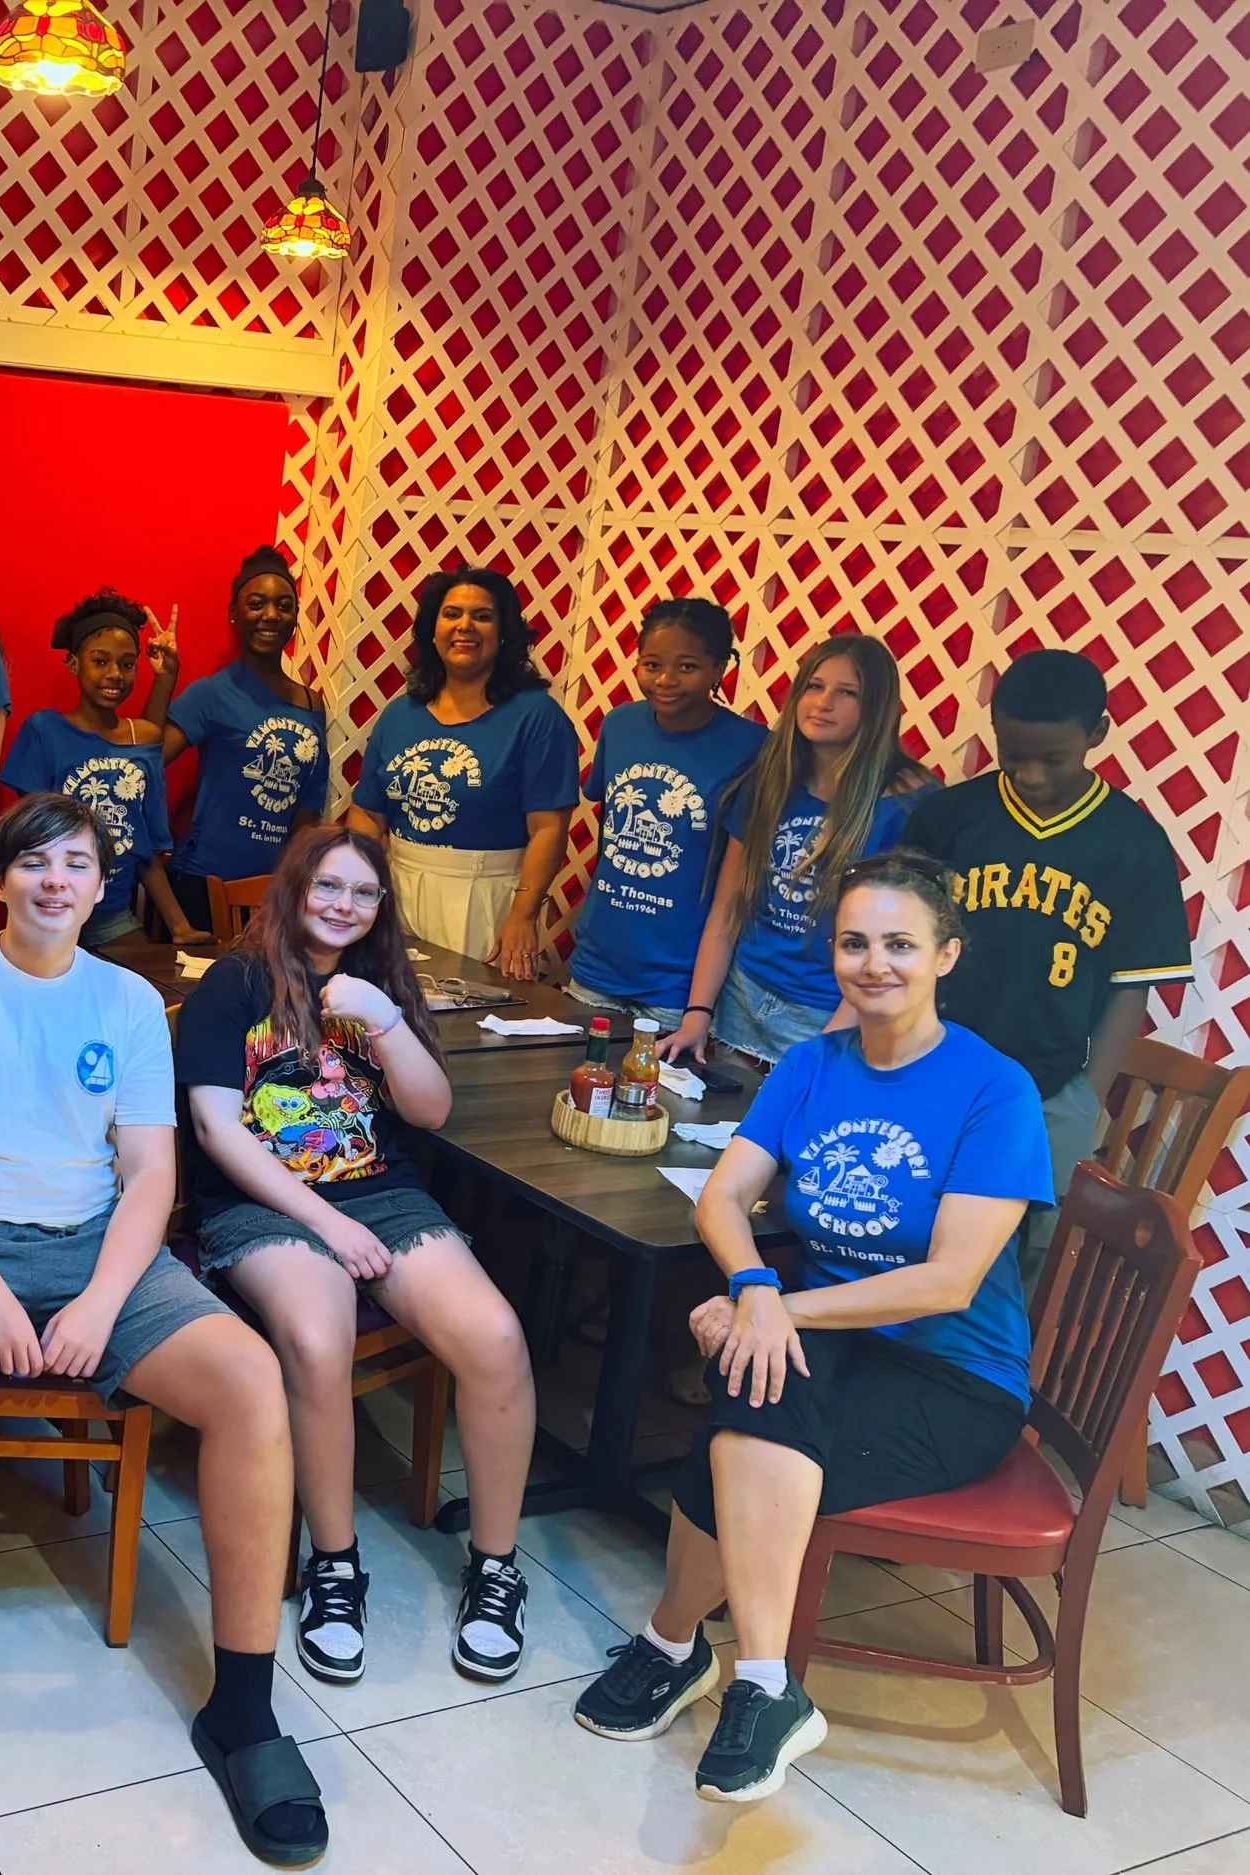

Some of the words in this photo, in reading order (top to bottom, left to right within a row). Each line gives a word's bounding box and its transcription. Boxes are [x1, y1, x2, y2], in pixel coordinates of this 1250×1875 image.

[404, 738, 482, 787] MONTESSORI
[614, 763, 708, 831] MONTESSORI
[238, 815, 257, 829] St.
[604, 843, 680, 878] SCHOOL
[597, 879, 616, 894] St.
[620, 885, 674, 908] Thomas
[610, 898, 625, 909] Est.
[1048, 942, 1078, 988] 8
[819, 1118, 932, 1179] MONTESSORI
[808, 1201, 900, 1238] SCHOOL
[809, 1239, 834, 1253] St.
[837, 1245, 906, 1264] Thomas
